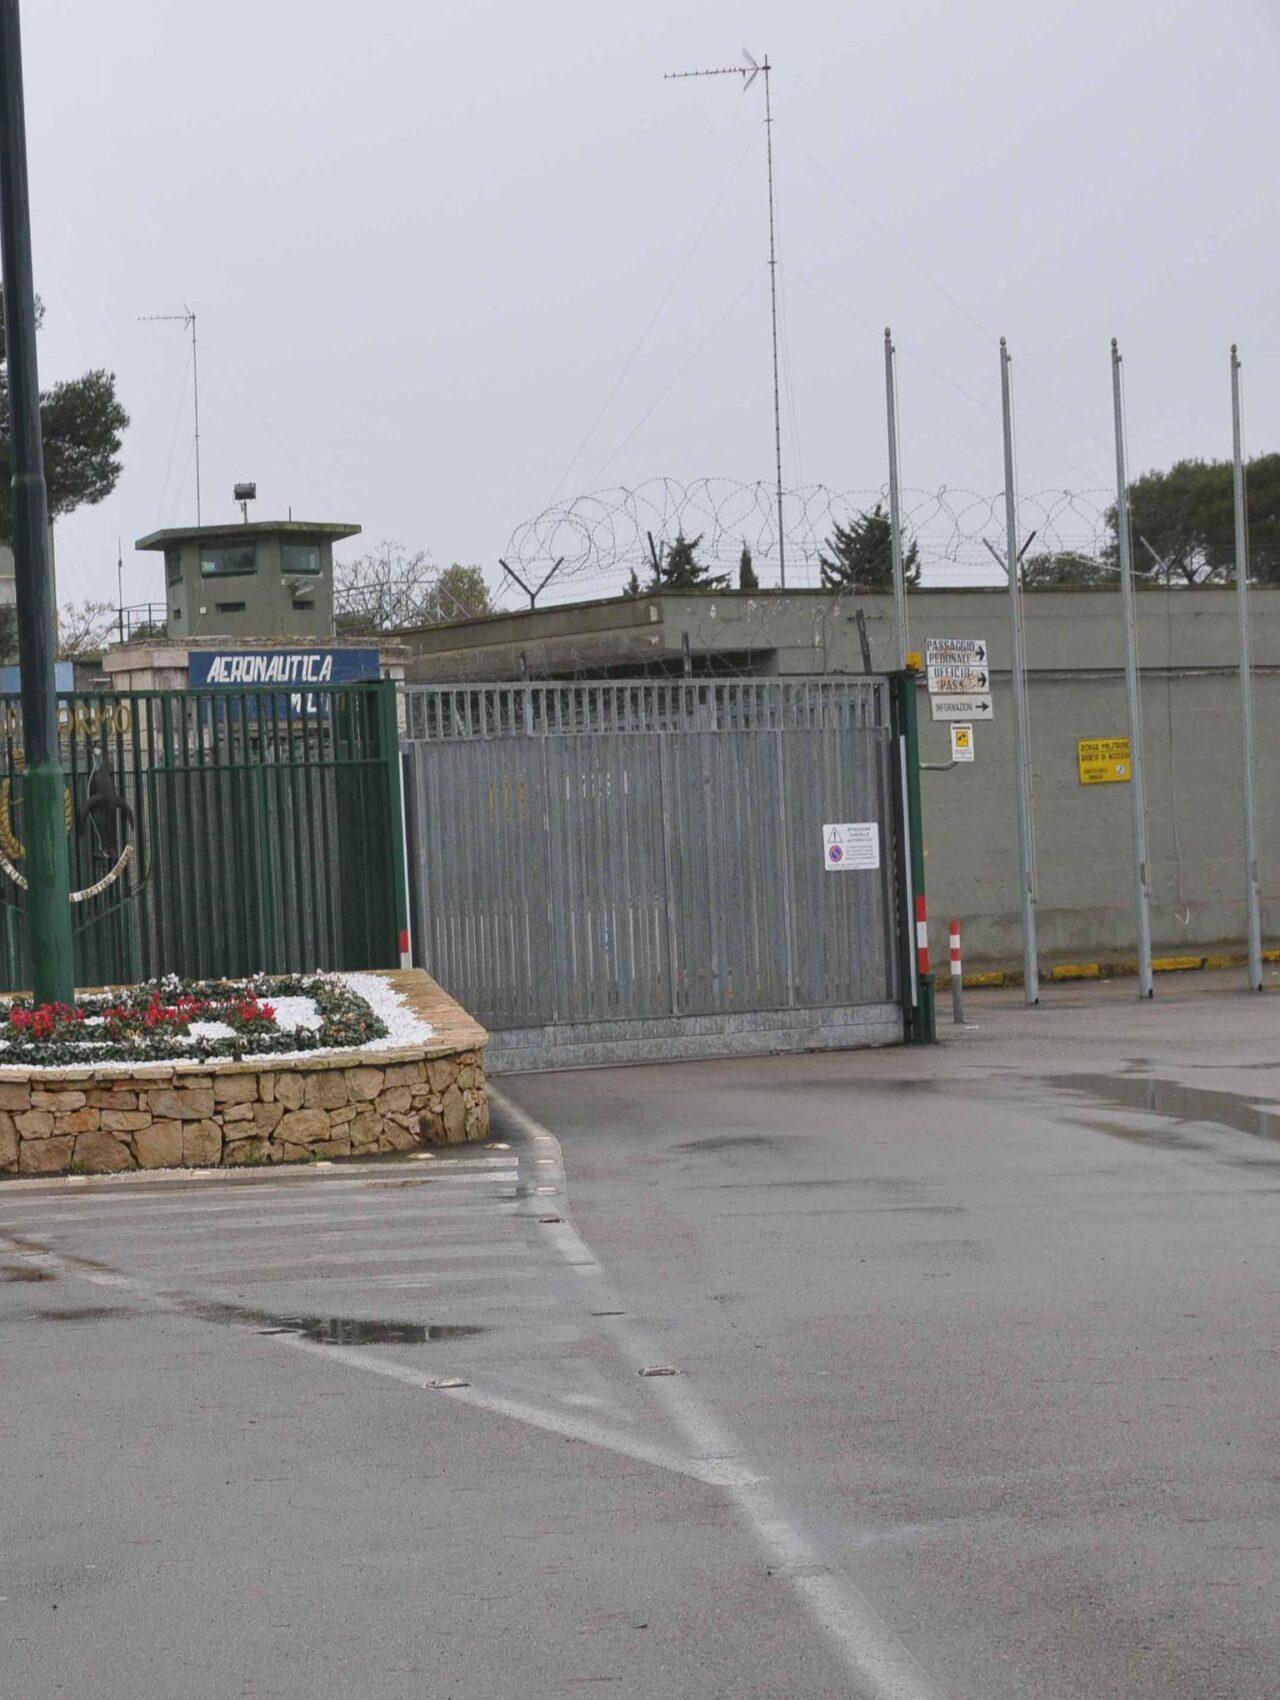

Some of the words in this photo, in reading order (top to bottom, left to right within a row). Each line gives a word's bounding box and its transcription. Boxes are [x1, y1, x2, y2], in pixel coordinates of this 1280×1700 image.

[927, 640, 975, 652] PASSAGGIO
[206, 654, 333, 683] AERONAUTICA
[940, 679, 965, 691] PASS
[935, 702, 974, 713] INFORMAZIONI
